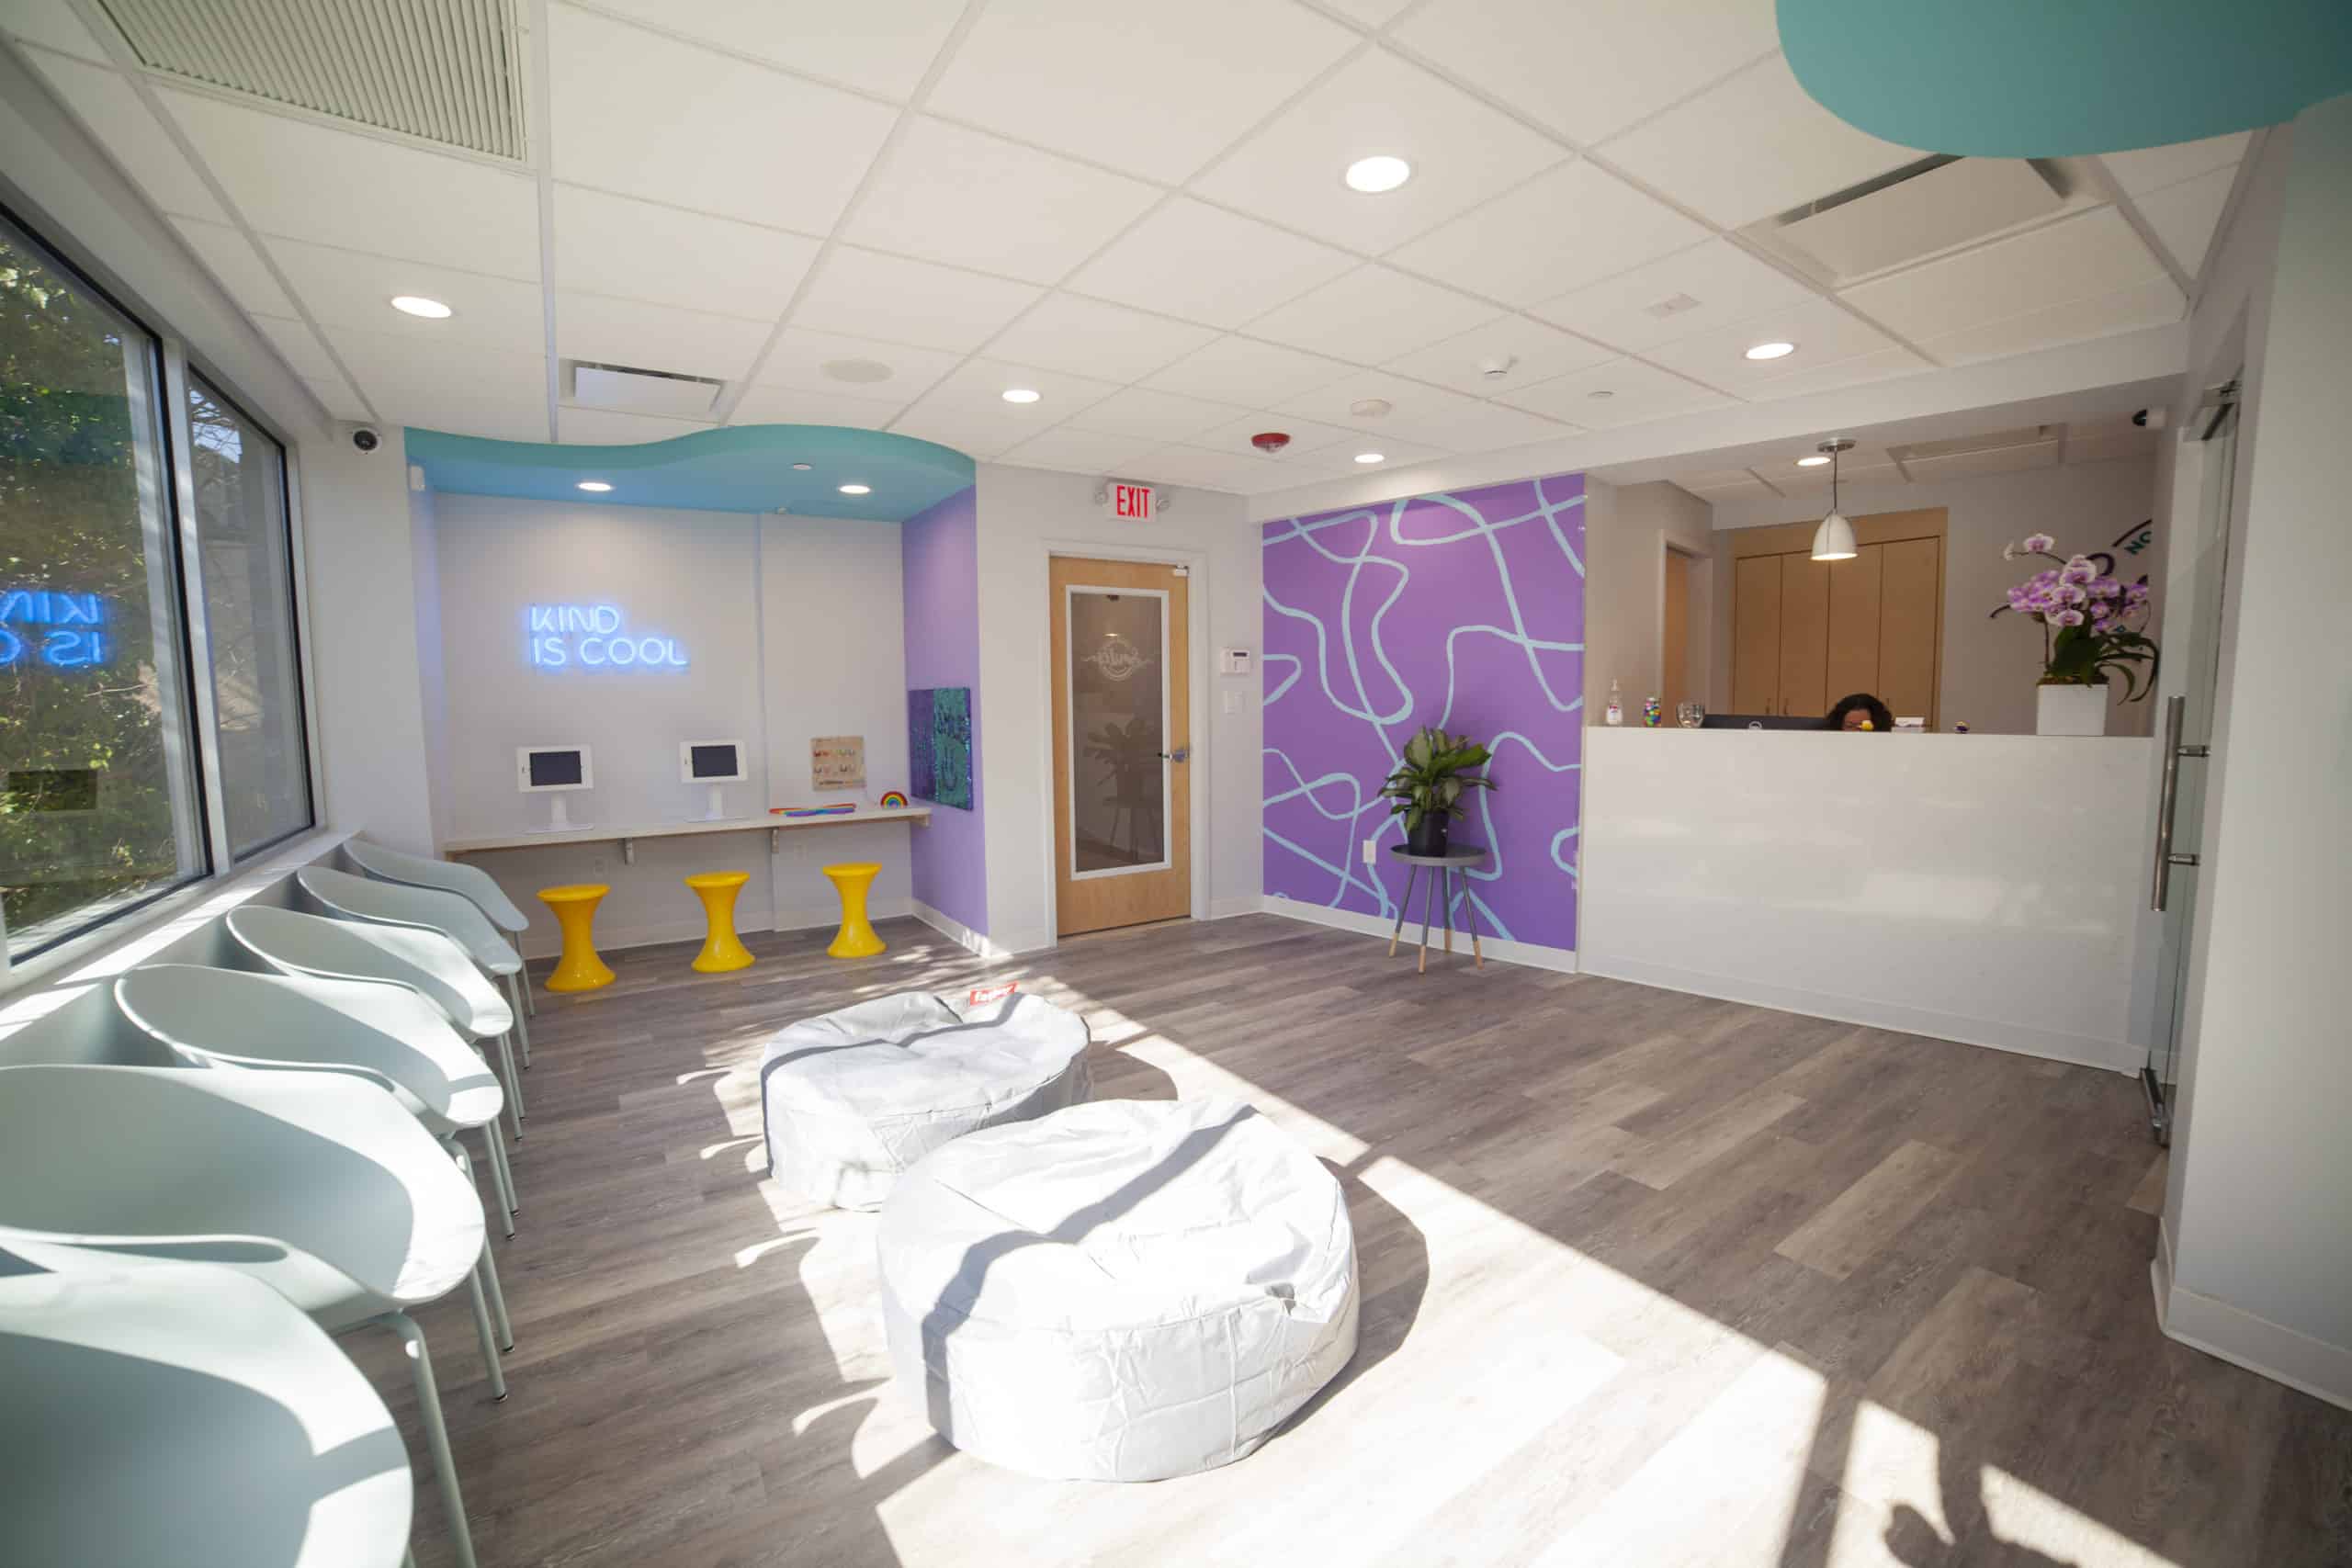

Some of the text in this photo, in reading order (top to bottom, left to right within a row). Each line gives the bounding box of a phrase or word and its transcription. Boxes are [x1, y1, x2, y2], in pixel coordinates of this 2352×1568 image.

[1116, 484, 1151, 519] EXIT
[530, 604, 621, 635] KIND
[533, 637, 689, 666] IS COOL
